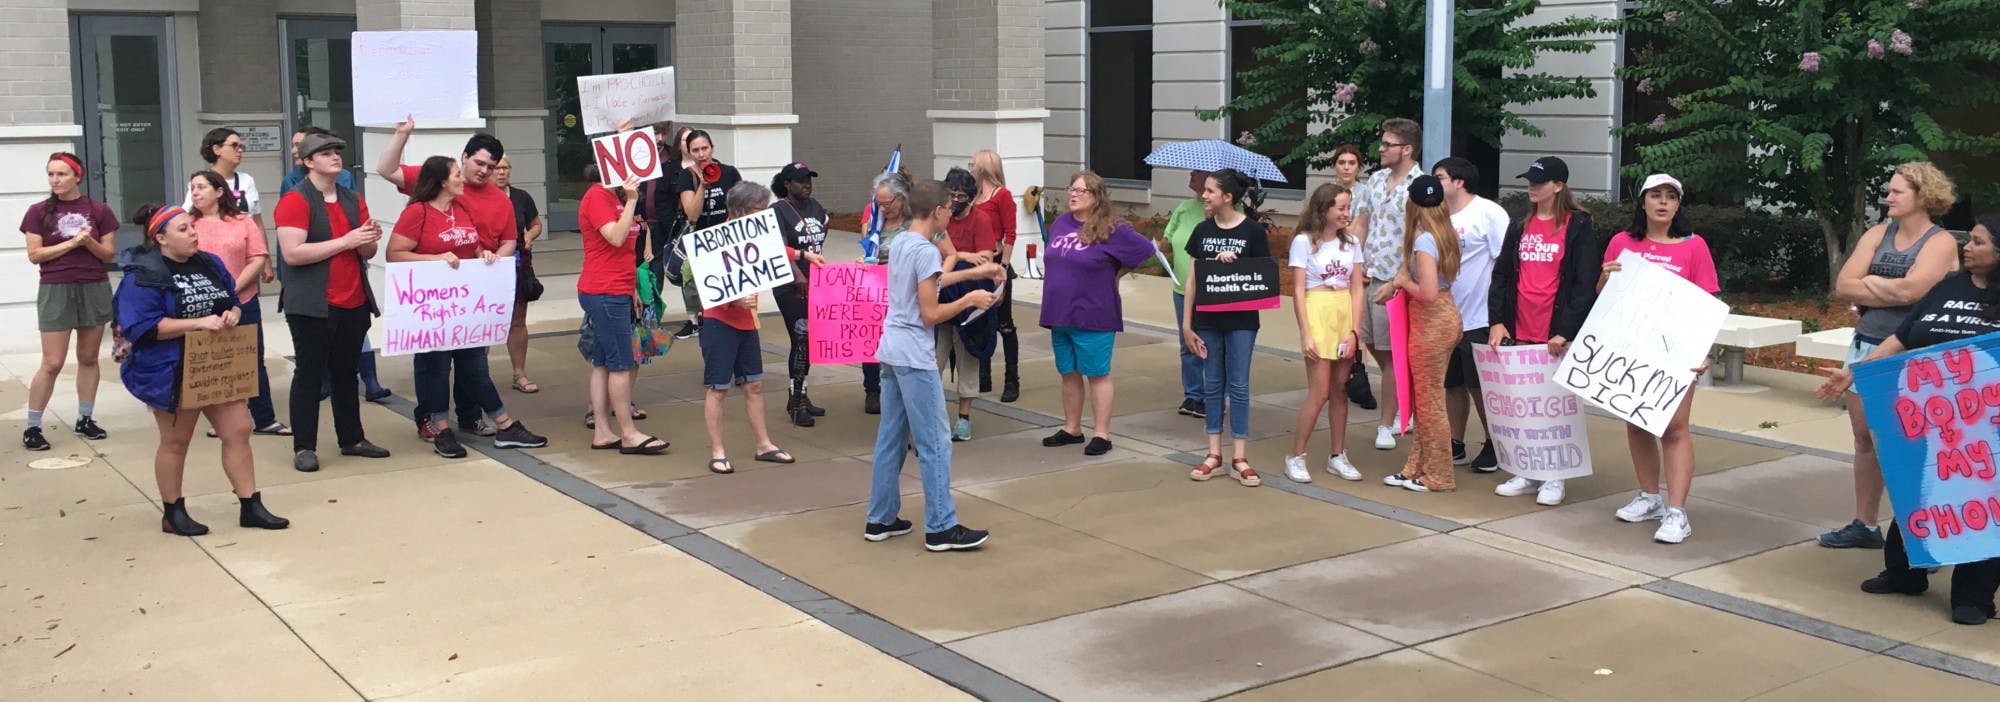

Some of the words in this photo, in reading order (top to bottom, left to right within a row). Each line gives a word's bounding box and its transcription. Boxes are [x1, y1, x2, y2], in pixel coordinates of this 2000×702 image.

[594, 131, 657, 185] NO
[693, 214, 776, 257] ABORTION:
[1206, 237, 1227, 246] HAVE
[1228, 238, 1247, 247] TIME
[1520, 233, 1544, 242] ANS
[721, 242, 760, 273] NO
[1203, 244, 1214, 252] TO
[1215, 245, 1242, 254] LISTEN
[1519, 252, 1554, 262] ODIES
[1534, 243, 1559, 253] OUR
[1644, 252, 1672, 262] Planned
[392, 268, 469, 305] Womens
[704, 255, 791, 303] SHAME
[814, 267, 824, 287] I
[825, 267, 868, 286] CANT
[1206, 272, 1252, 283] Abortion
[1253, 272, 1263, 281] is
[846, 286, 888, 302] BELIE
[1206, 283, 1240, 292] Health
[1241, 283, 1269, 292] Care.
[413, 302, 466, 329] Rights
[473, 295, 506, 315] Are
[816, 302, 863, 321] WE'RE
[1920, 313, 1938, 322] IS
[1936, 314, 1950, 322] A
[387, 329, 447, 353] HUMAN
[451, 324, 509, 345] RIGHTS
[840, 323, 883, 340] PROT
[816, 340, 853, 359] THIS
[1573, 334, 1650, 393] SUCK
[1640, 368, 1689, 412] MY
[1906, 349, 1975, 393] MY
[1485, 390, 1579, 419] CHOICE
[1567, 366, 1655, 426] DICK
[1491, 423, 1520, 440] WHY
[1524, 424, 1573, 440] WITH
[1513, 443, 1583, 471] CHILD
[1936, 440, 1997, 481] MY
